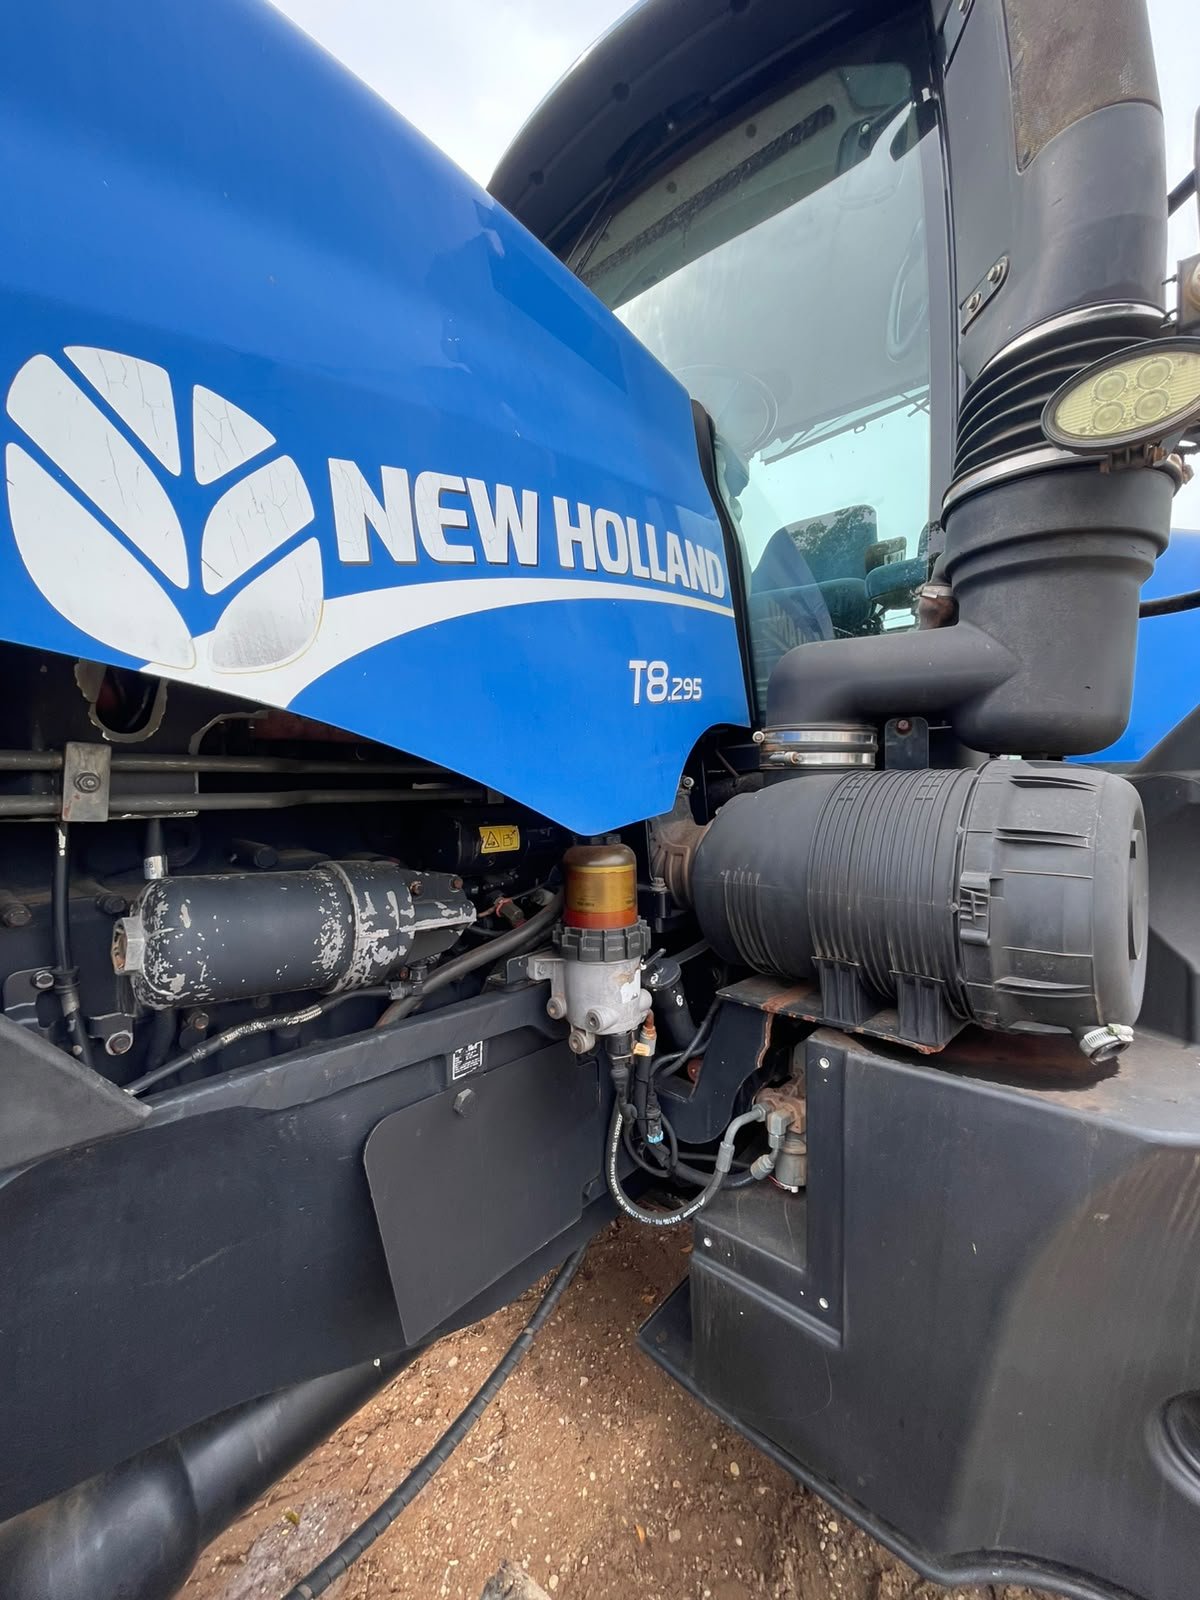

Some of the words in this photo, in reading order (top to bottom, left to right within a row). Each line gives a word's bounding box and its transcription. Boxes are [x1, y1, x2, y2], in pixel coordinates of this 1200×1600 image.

[328, 458, 539, 566] NEW
[553, 496, 726, 599] HOLLAND
[628, 660, 702, 705] T8.295
